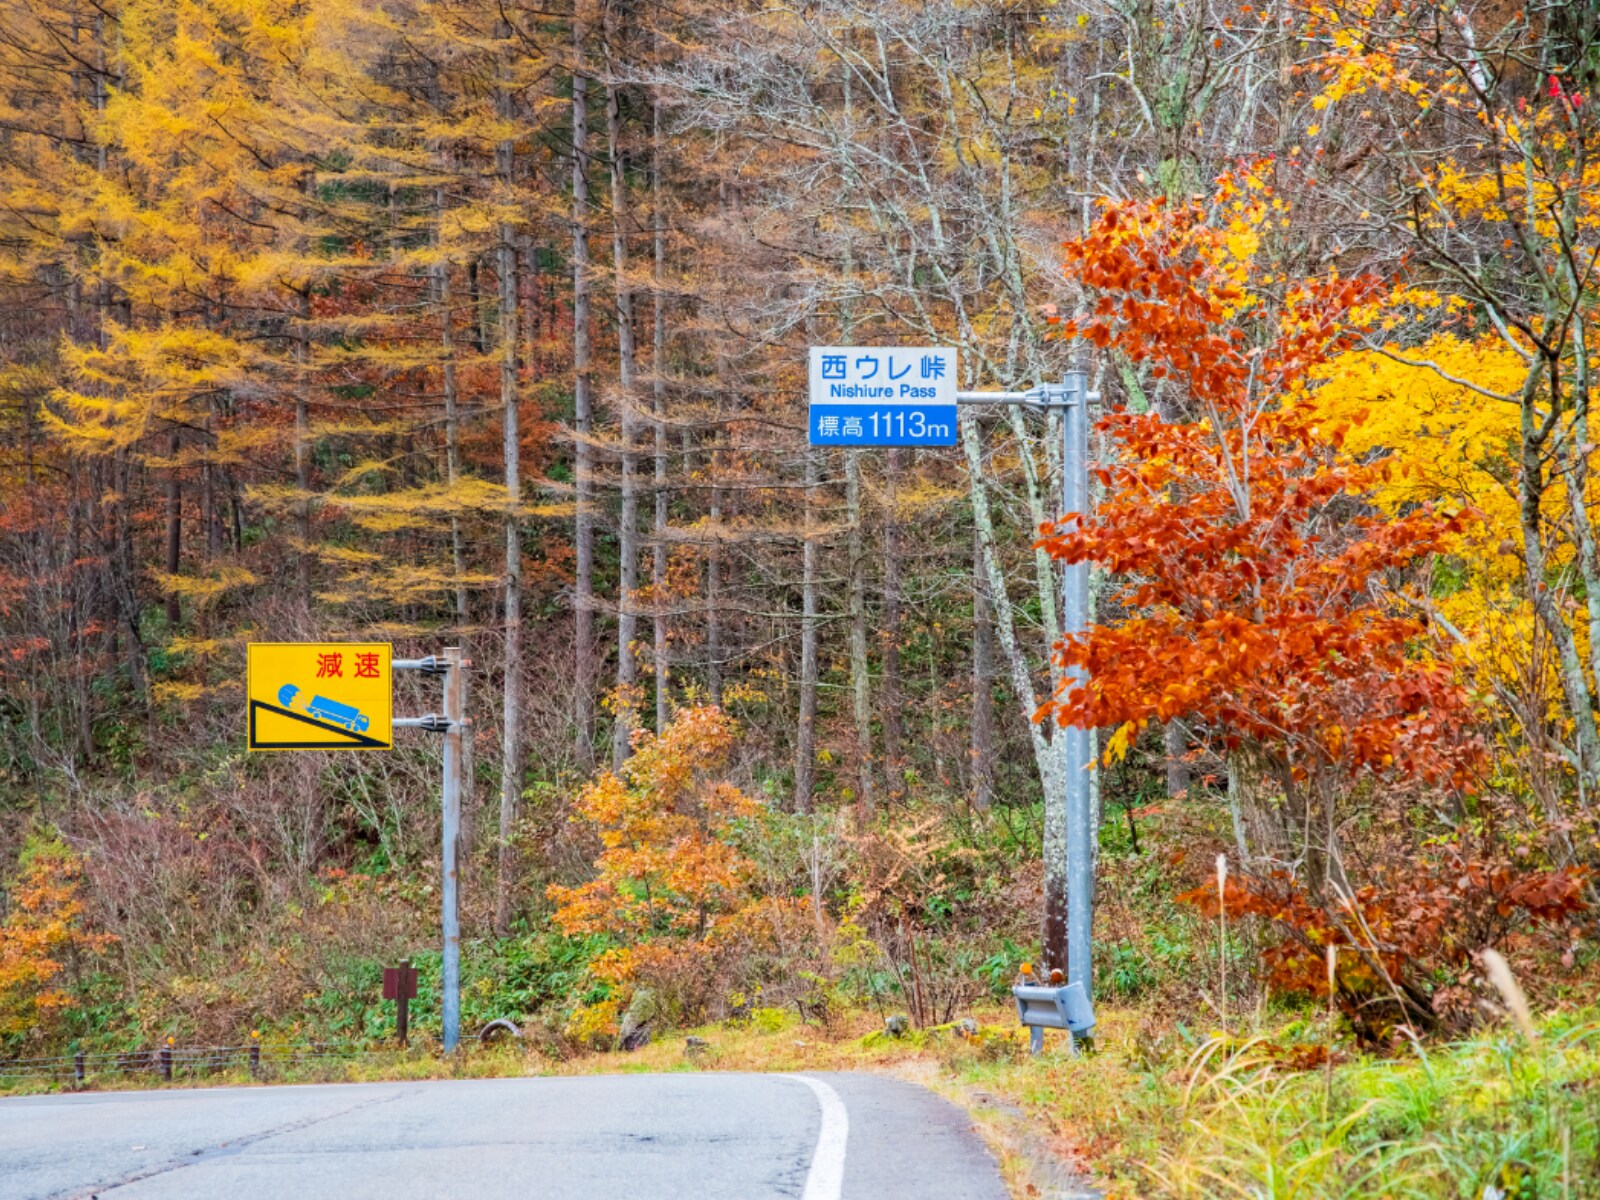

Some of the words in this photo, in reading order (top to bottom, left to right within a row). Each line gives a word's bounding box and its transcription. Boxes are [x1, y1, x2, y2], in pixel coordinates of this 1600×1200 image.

[821, 354, 946, 380] 西ウレ峠
[830, 384, 894, 398] Nishiure
[899, 384, 937, 398] Pass
[316, 651, 381, 678] 減速
